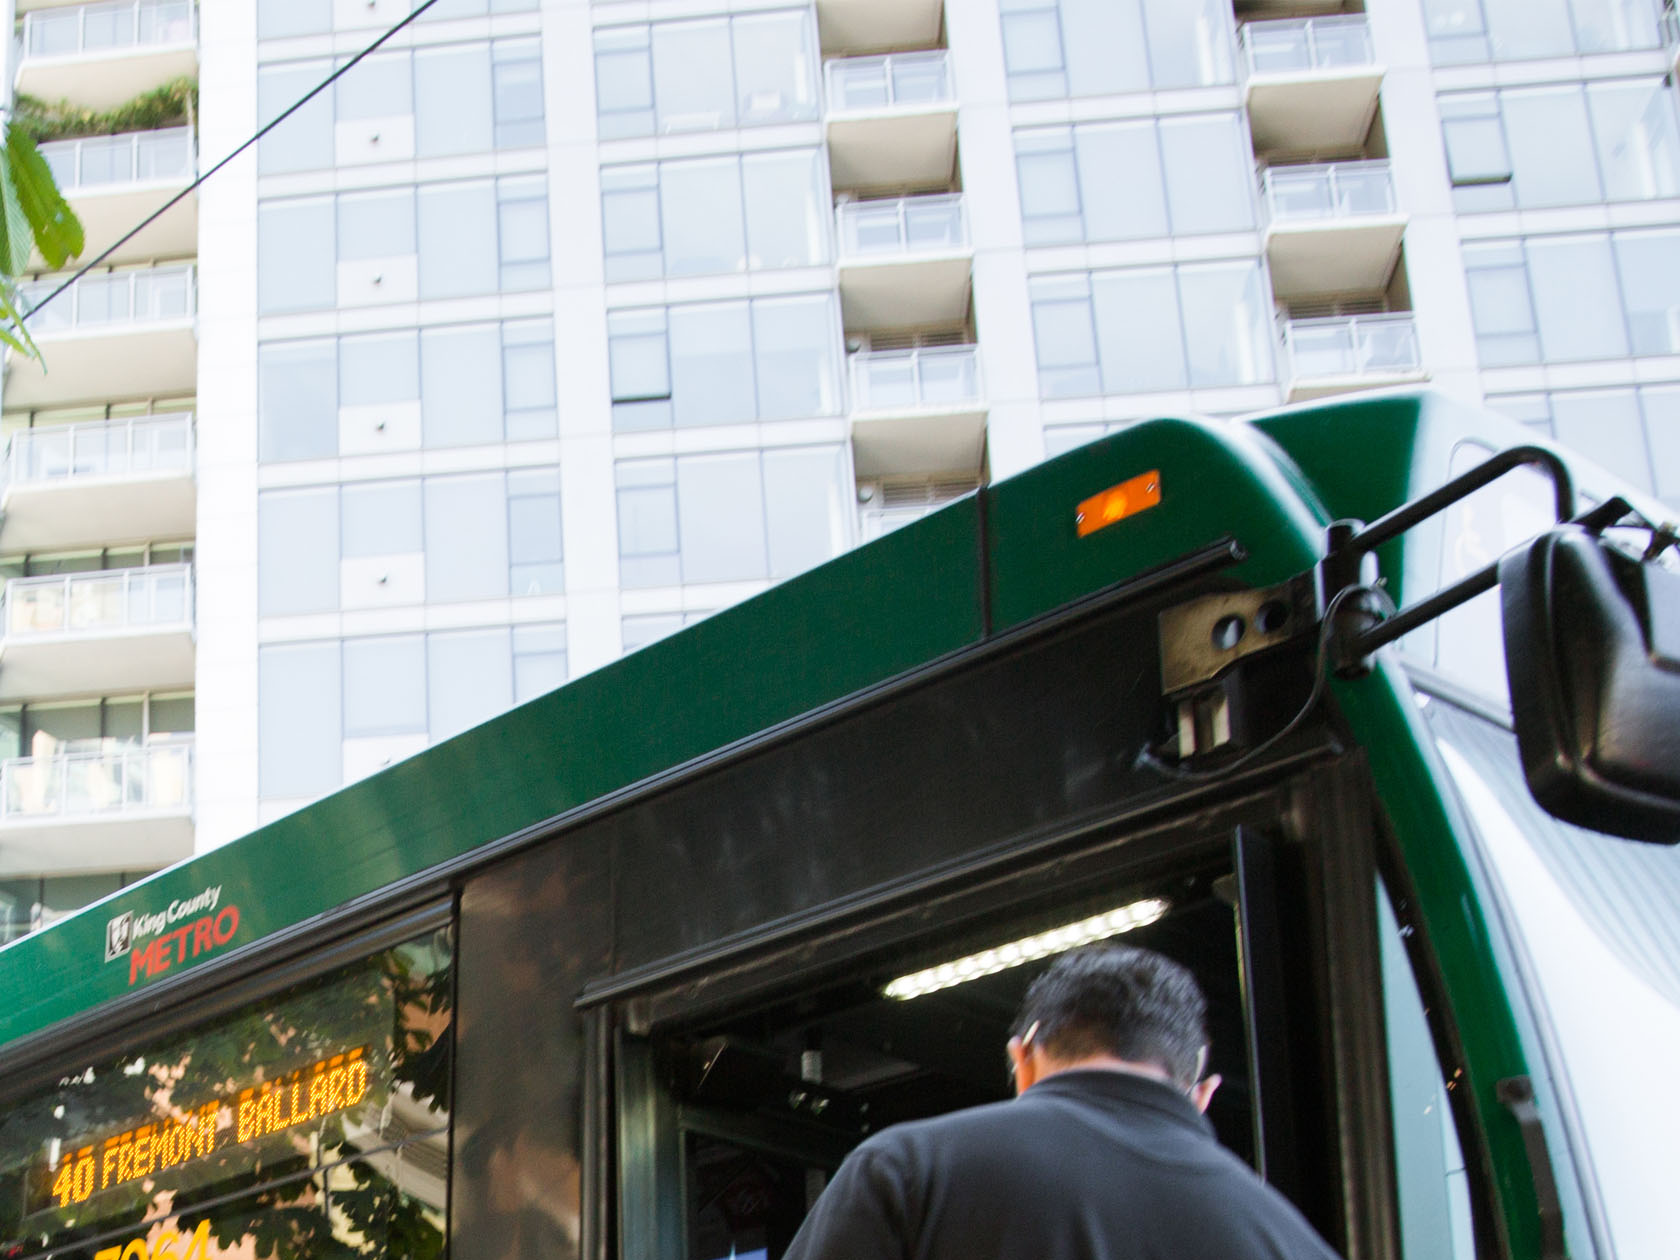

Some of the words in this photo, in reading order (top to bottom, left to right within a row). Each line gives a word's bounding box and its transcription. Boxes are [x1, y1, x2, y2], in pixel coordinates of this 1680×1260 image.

[128, 904, 240, 987] METRO
[132, 912, 168, 941] King
[166, 884, 223, 924] County
[52, 1155, 96, 1208] 40
[101, 1111, 219, 1190] FREMONT
[237, 1057, 367, 1144] BALLARD
